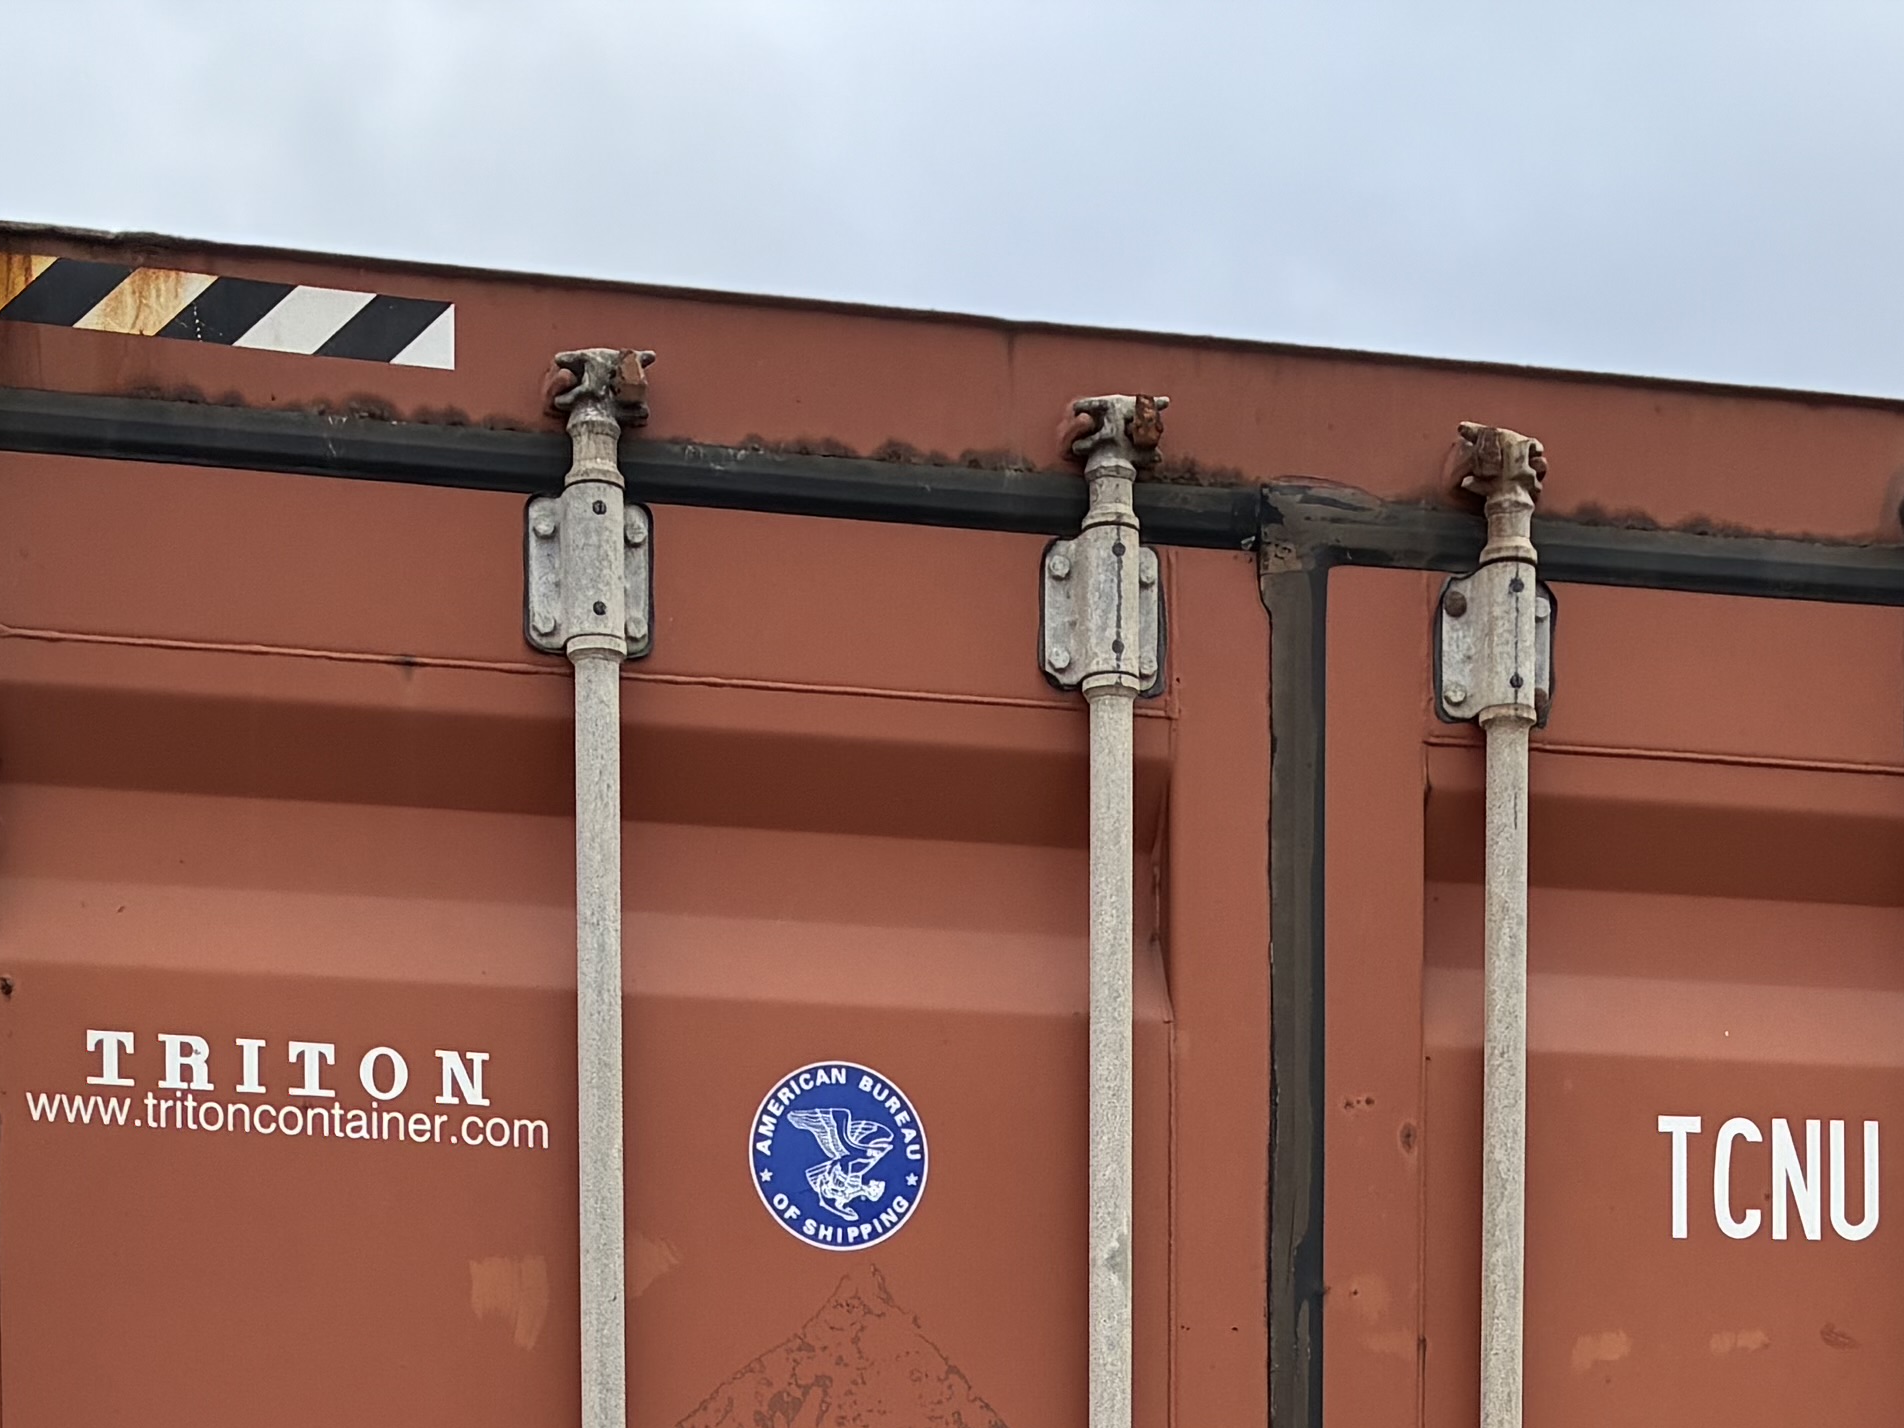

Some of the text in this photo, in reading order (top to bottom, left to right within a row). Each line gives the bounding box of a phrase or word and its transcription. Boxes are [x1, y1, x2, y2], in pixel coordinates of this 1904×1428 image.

[85, 1029, 491, 1107] TRITON
[26, 1088, 549, 1149] www.tritoncontainer.com
[756, 1068, 922, 1160] AMERICAN BUREAU
[1658, 1116, 1879, 1241] TCNU
[772, 1193, 910, 1243] OF SHIPPING
